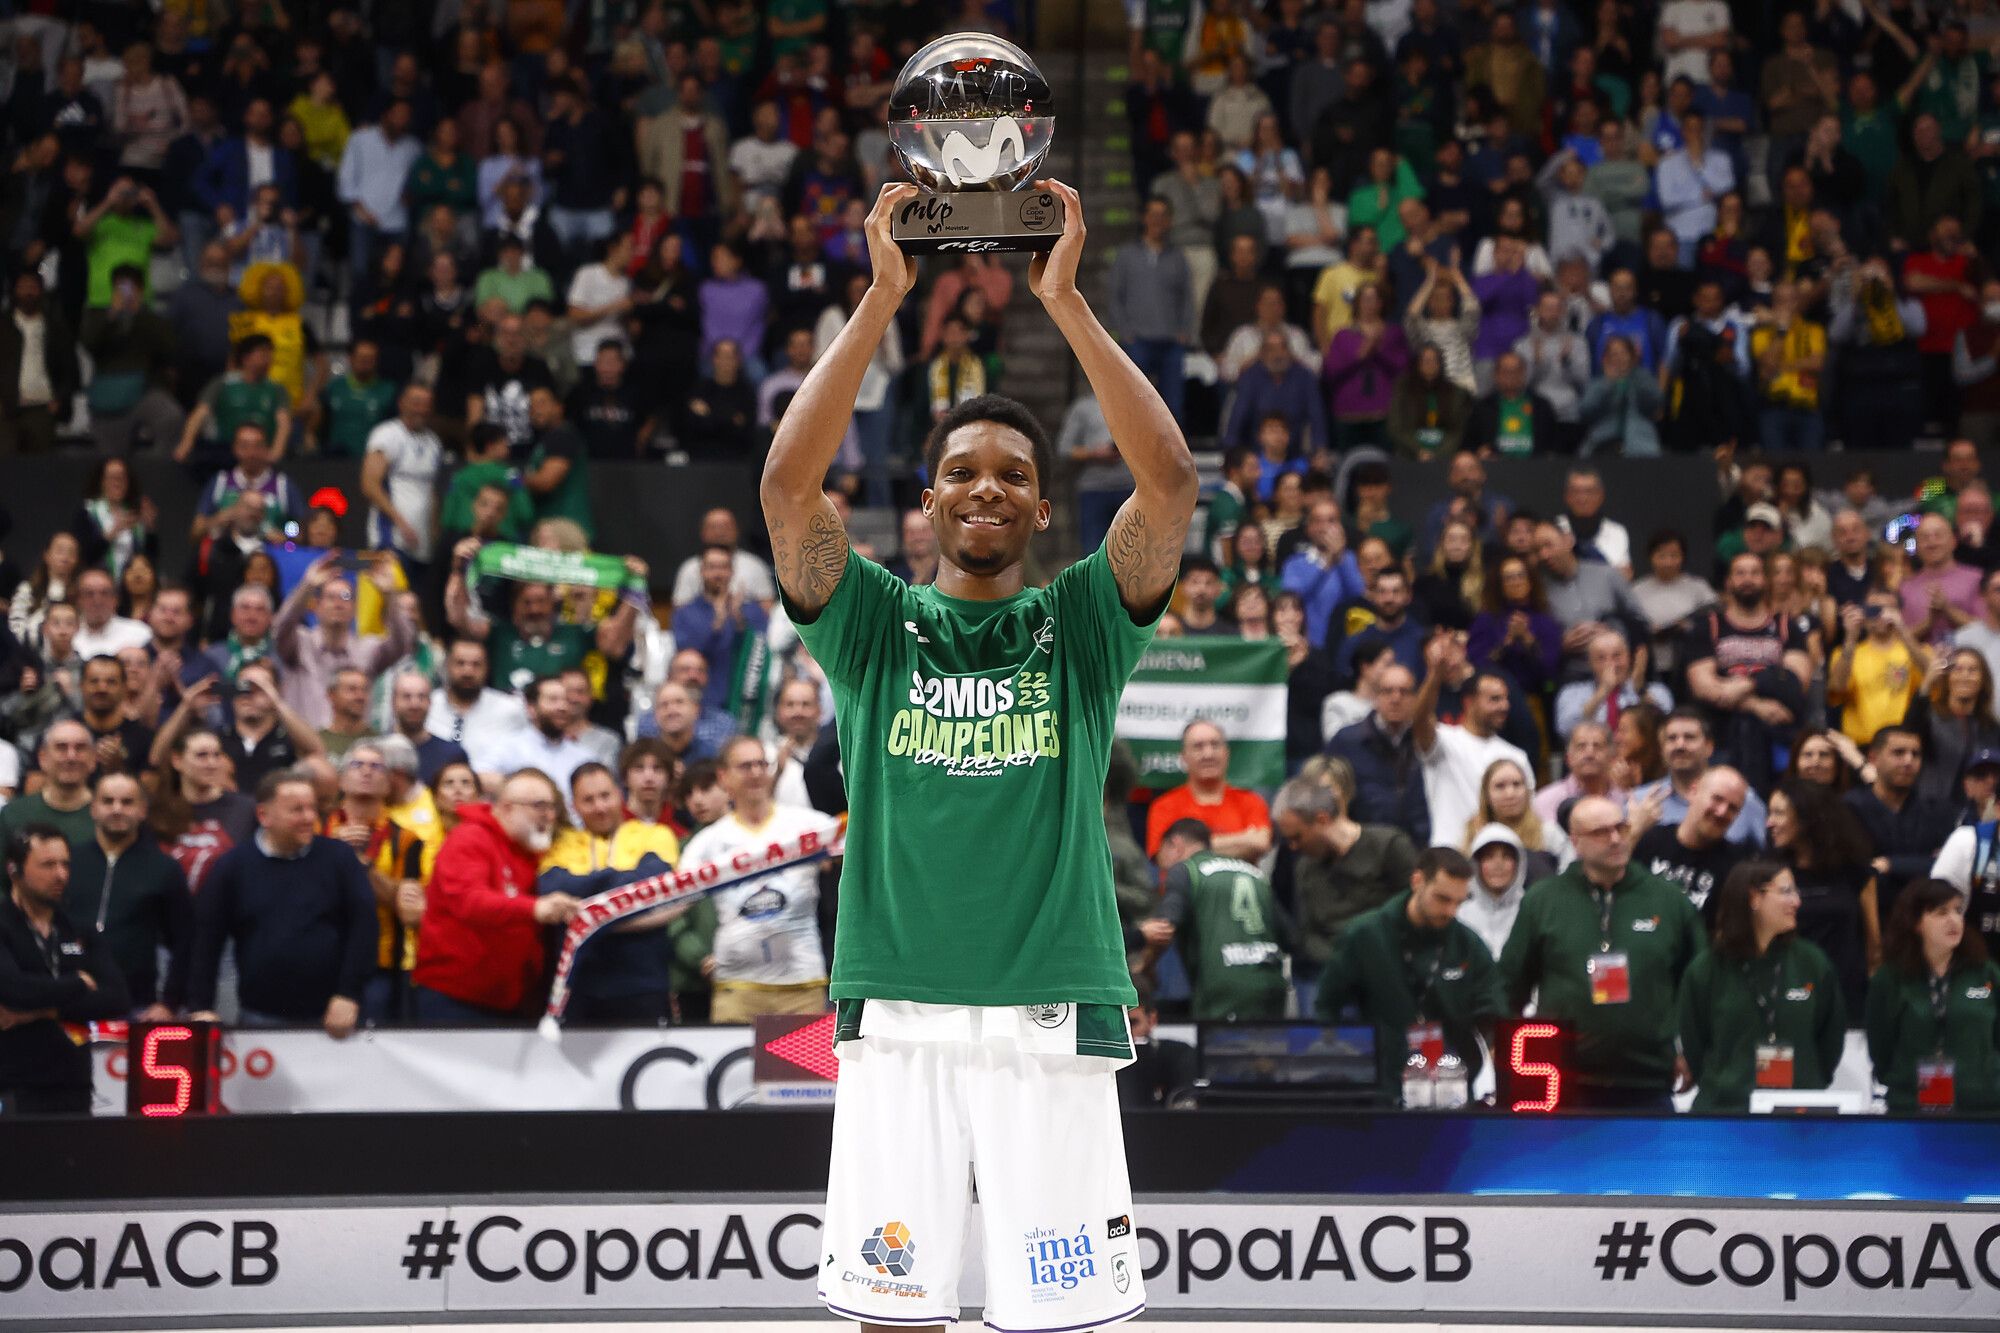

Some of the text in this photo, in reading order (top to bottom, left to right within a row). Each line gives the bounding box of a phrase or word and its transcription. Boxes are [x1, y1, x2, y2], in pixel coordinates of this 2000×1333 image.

[909, 670, 1014, 718] S2MOS
[1017, 671, 1051, 688] 22
[1017, 689, 1051, 709] 23
[887, 708, 1060, 765] CAMPEONES
[946, 767, 1003, 777] BADALONA
[961, 753, 1003, 770] DEL
[1230, 873, 1265, 934] 4
[141, 1026, 192, 1117] 5
[1511, 1023, 1560, 1112] 5
[1024, 1226, 1057, 1240] sabor
[1038, 1223, 1095, 1262] má
[1109, 1224, 1127, 1237] acb
[1028, 1256, 1098, 1290] laga
